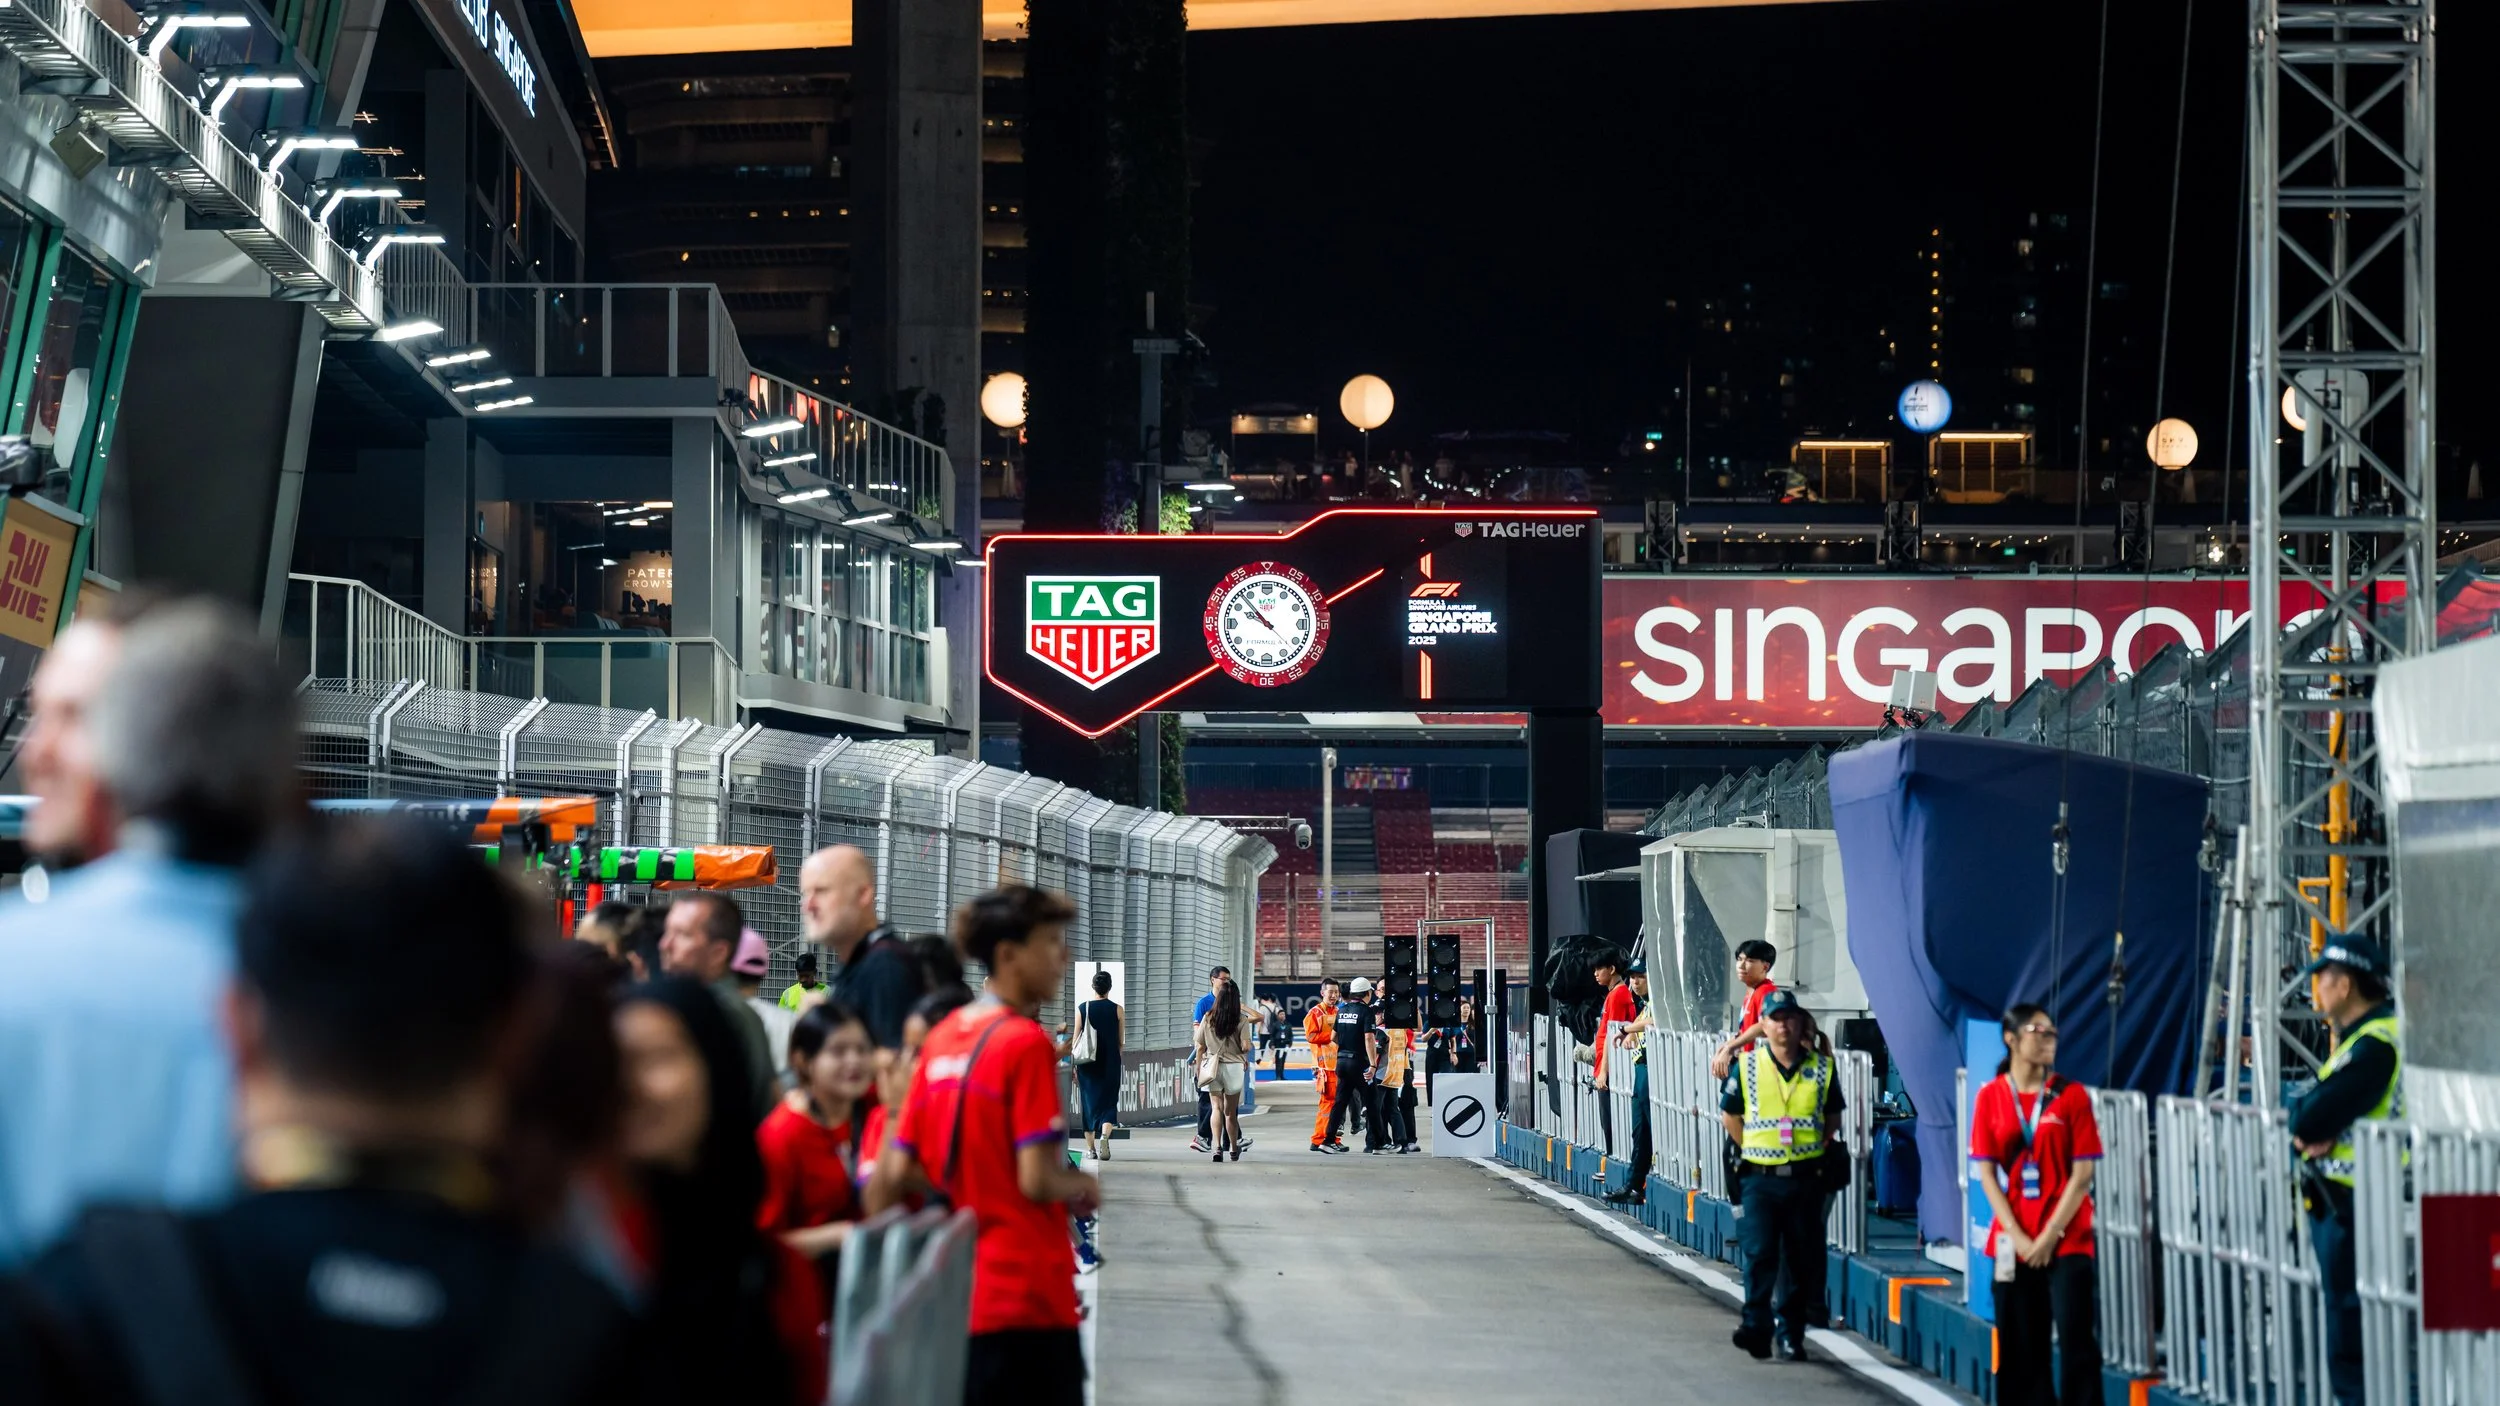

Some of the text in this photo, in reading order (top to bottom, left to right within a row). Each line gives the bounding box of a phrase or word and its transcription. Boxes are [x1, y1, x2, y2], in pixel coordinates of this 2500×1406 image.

[494, 10, 536, 118] SINGAPORE
[1038, 585, 1147, 617] TAG
[1408, 612, 1492, 623] SINGAPORE
[1408, 622, 1498, 633] GRAND PRIX
[1408, 636, 1437, 645] 2025
[1035, 628, 1151, 680] HEUER
